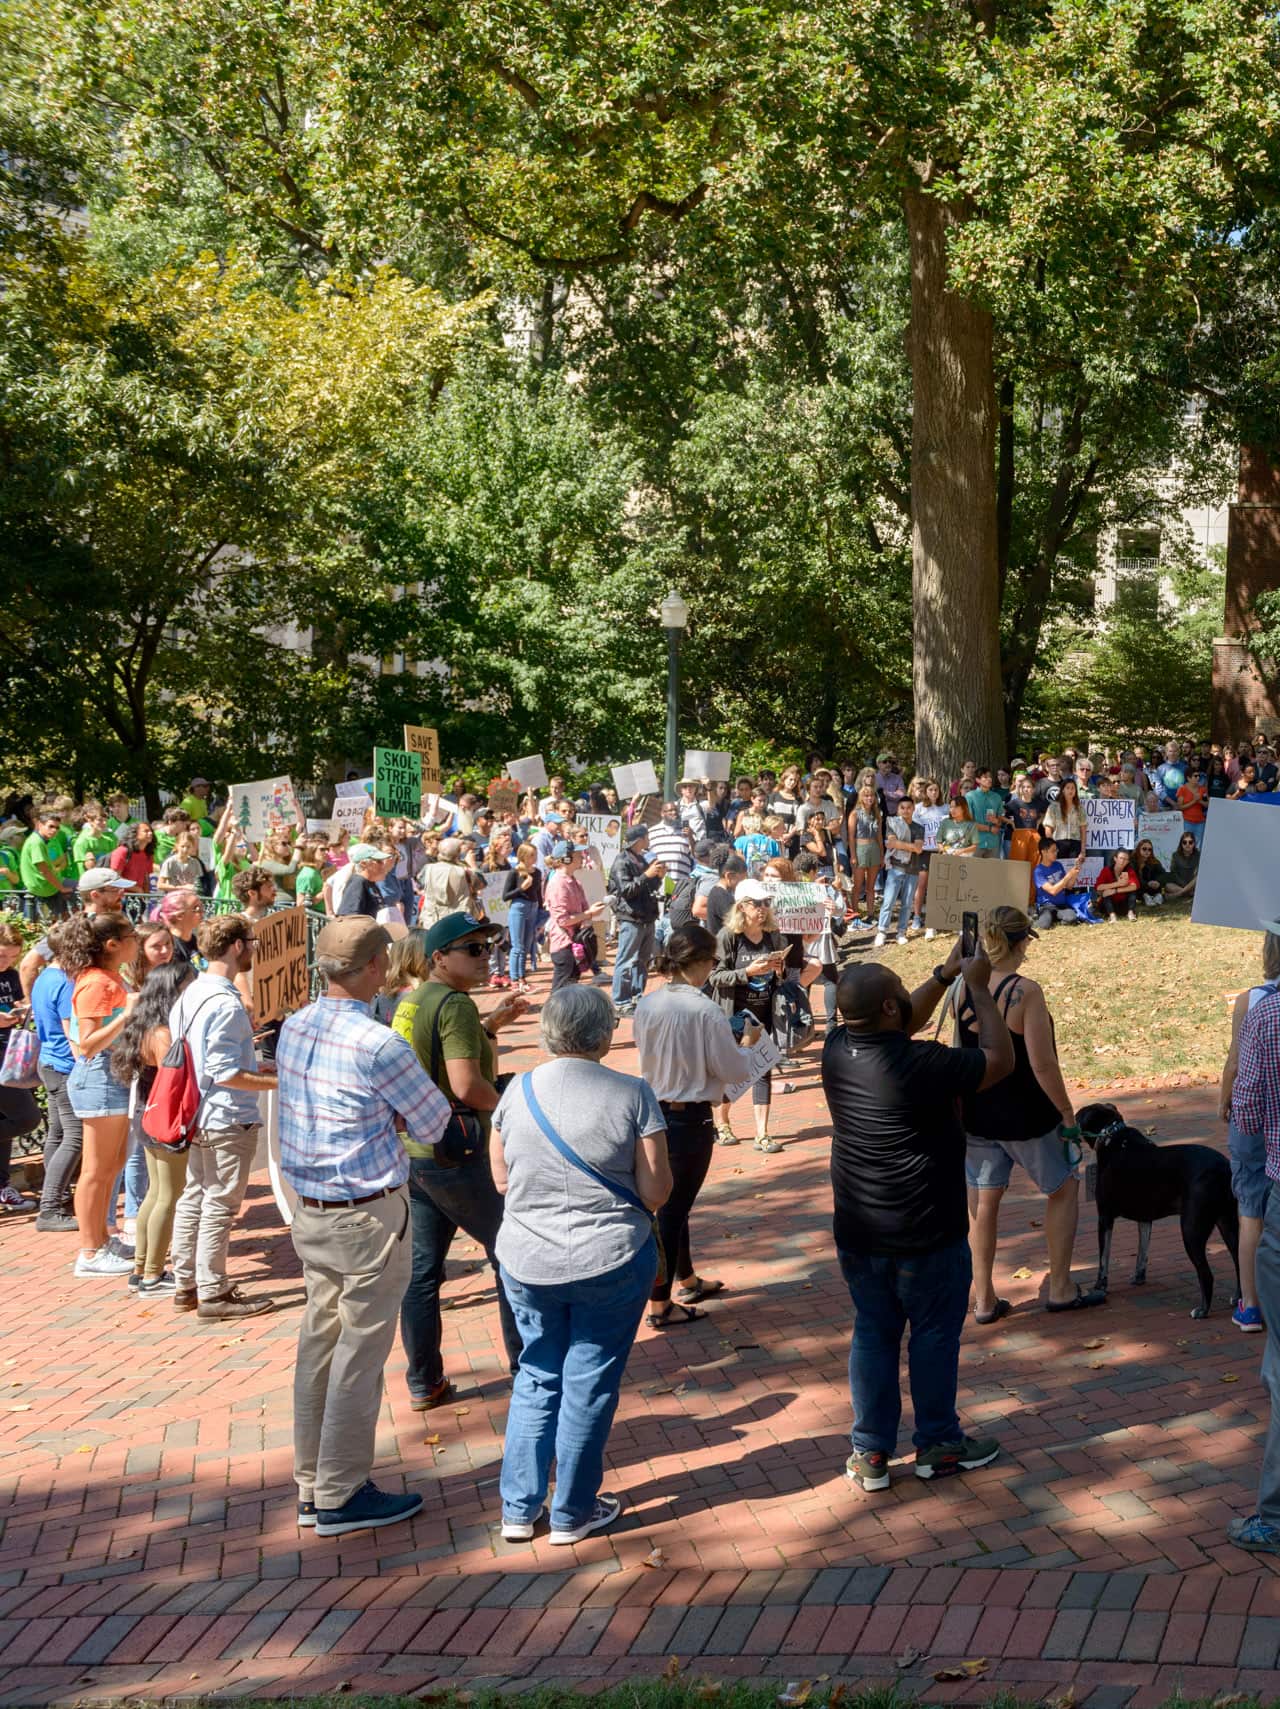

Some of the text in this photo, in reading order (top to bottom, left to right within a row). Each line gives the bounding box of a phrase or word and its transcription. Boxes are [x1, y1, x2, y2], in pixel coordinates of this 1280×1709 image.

[410, 733, 433, 751] SAVE
[384, 751, 418, 770] SKOL-
[377, 766, 419, 787] STREJK
[955, 888, 979, 903] Life
[256, 914, 305, 965] WHAT WILL
[259, 953, 307, 1018] IT TAKE?
